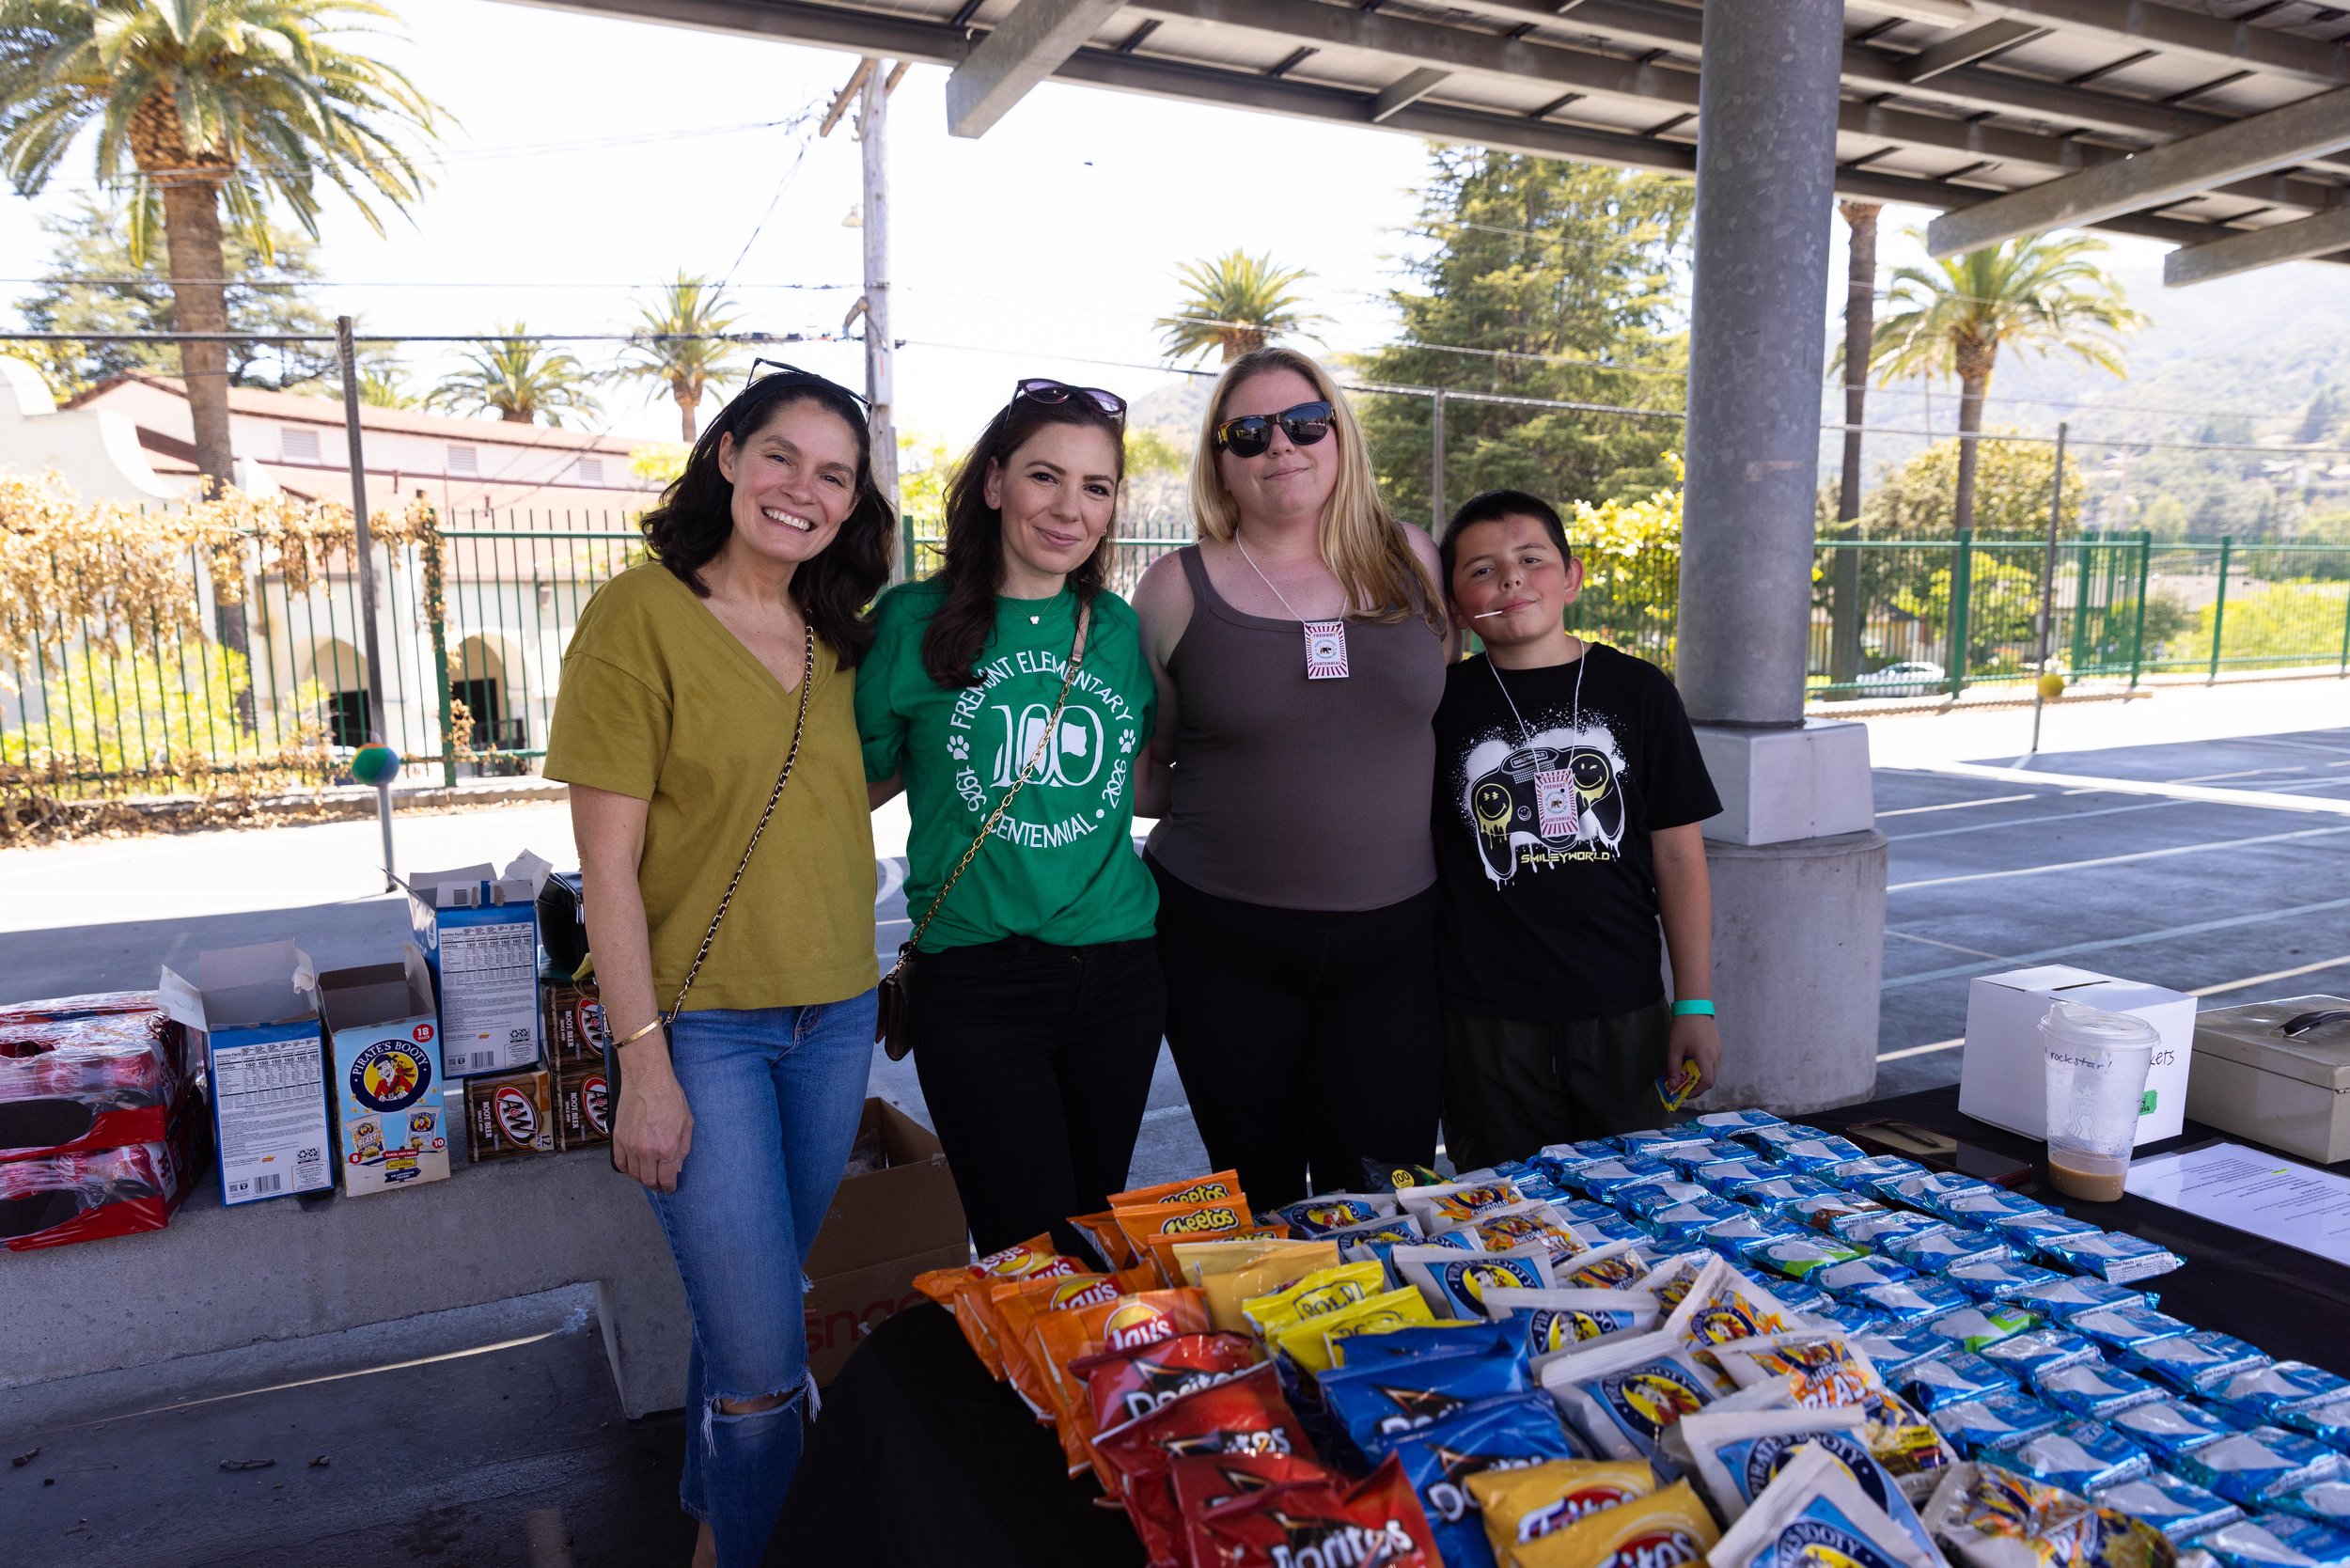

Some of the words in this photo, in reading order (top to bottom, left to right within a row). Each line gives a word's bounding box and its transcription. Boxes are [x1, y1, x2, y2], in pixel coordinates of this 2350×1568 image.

[1016, 650, 1134, 721] ELEMNTARY
[990, 703, 1104, 788] 100
[1102, 759, 1128, 809] 2026
[1521, 852, 1610, 864] SMILEYWORLD
[416, 1027, 430, 1036] 18
[567, 1029, 575, 1048] BEER
[352, 1042, 392, 1075] PIRATE'S
[395, 1041, 429, 1066] BOOTY
[482, 1101, 491, 1119] ROOT
[497, 1097, 537, 1135] A&W
[484, 1120, 494, 1139] BEER
[540, 1134, 552, 1147] 12
[1392, 1171, 1410, 1184] 100
[1471, 1200, 1510, 1217] CHEDDAR
[1163, 1209, 1235, 1234] Cheetos
[1512, 1230, 1549, 1246] CHEDDAR
